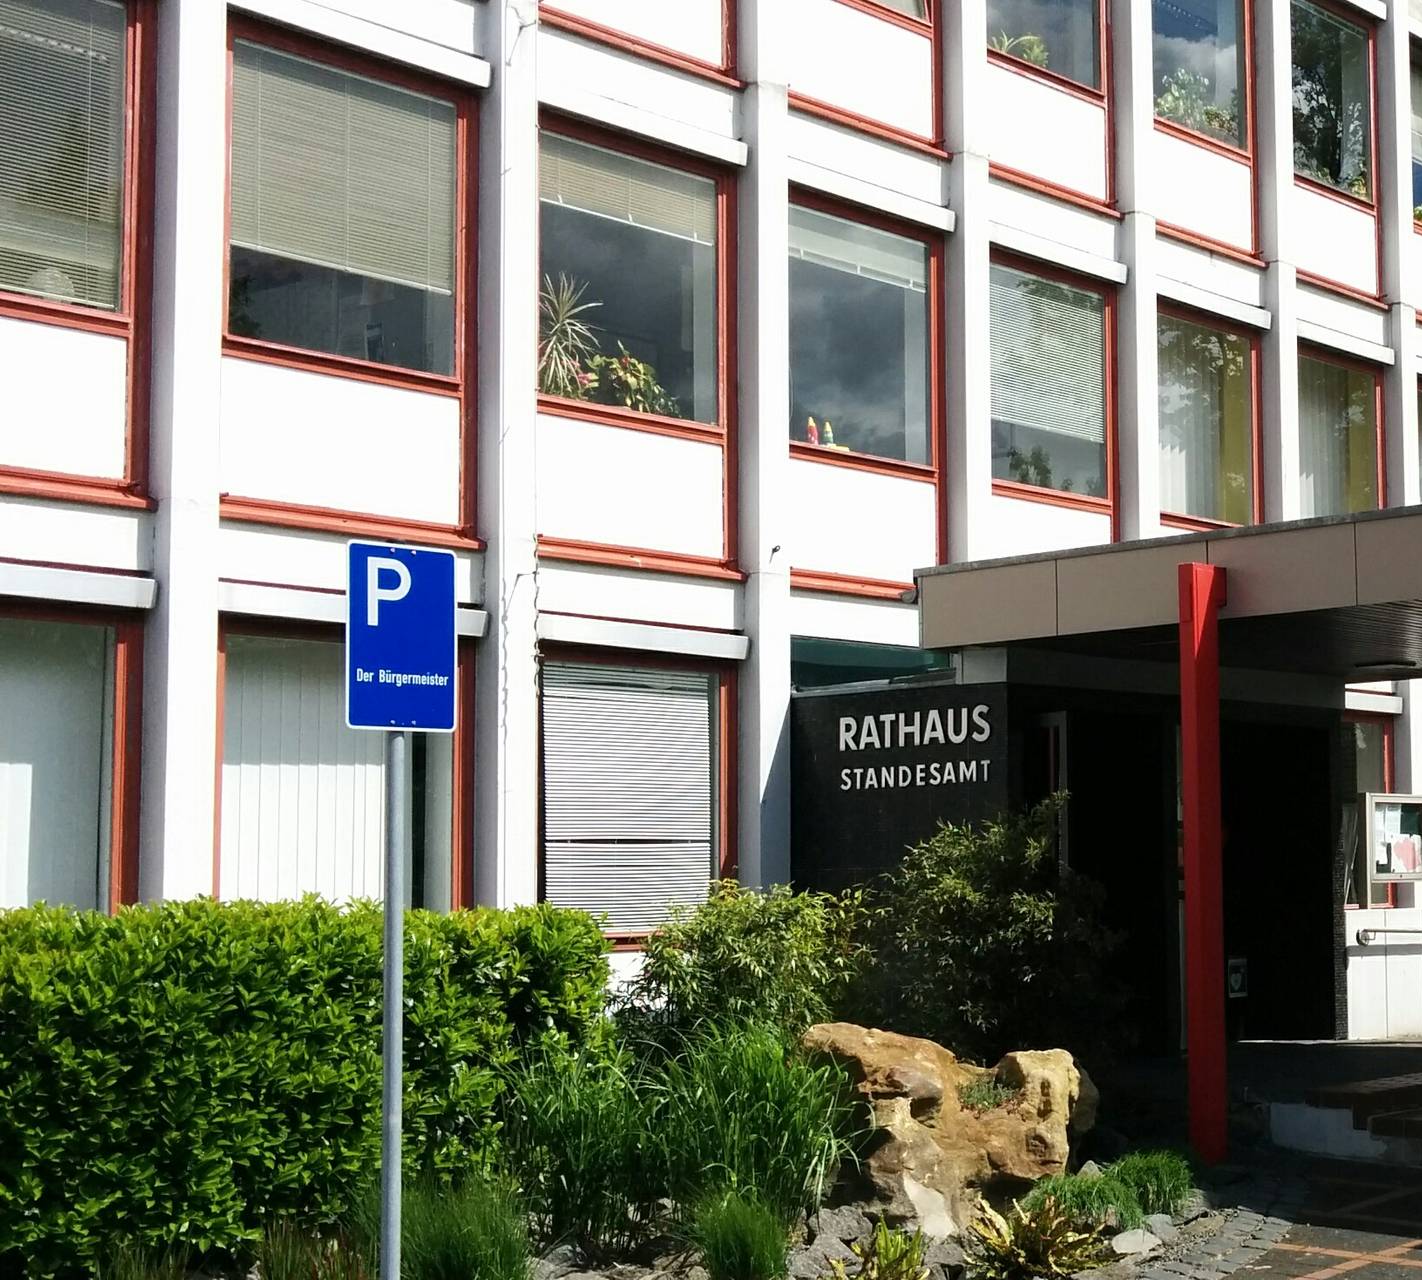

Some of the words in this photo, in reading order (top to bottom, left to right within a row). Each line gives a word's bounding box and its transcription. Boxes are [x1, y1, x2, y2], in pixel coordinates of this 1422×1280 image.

[367, 556, 412, 626] P
[356, 668, 374, 683] Der
[379, 669, 449, 687] Bürgermeister
[839, 704, 991, 751] RATHAUS
[840, 759, 991, 791] STANDESAMT
